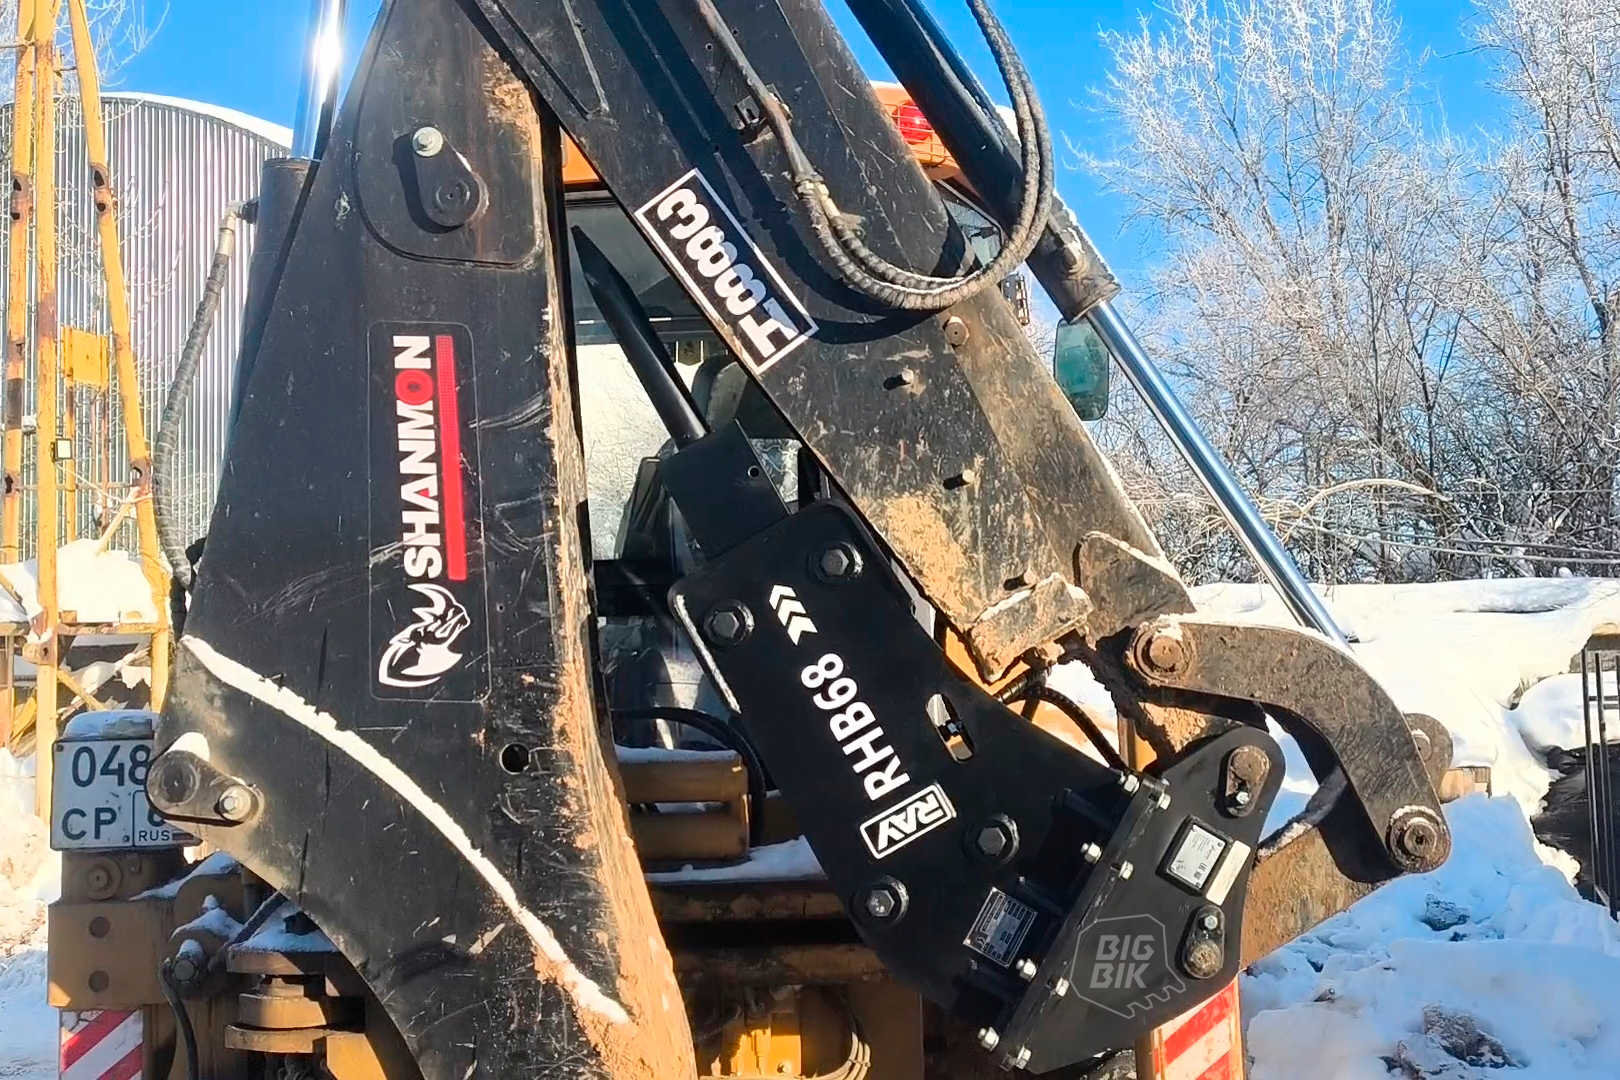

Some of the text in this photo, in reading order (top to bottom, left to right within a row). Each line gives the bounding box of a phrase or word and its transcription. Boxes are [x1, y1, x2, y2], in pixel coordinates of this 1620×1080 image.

[393, 335, 442, 579] SHANMON
[801, 652, 911, 801] RHB68
[138, 830, 170, 842] RUS
[877, 792, 944, 851] RAY
